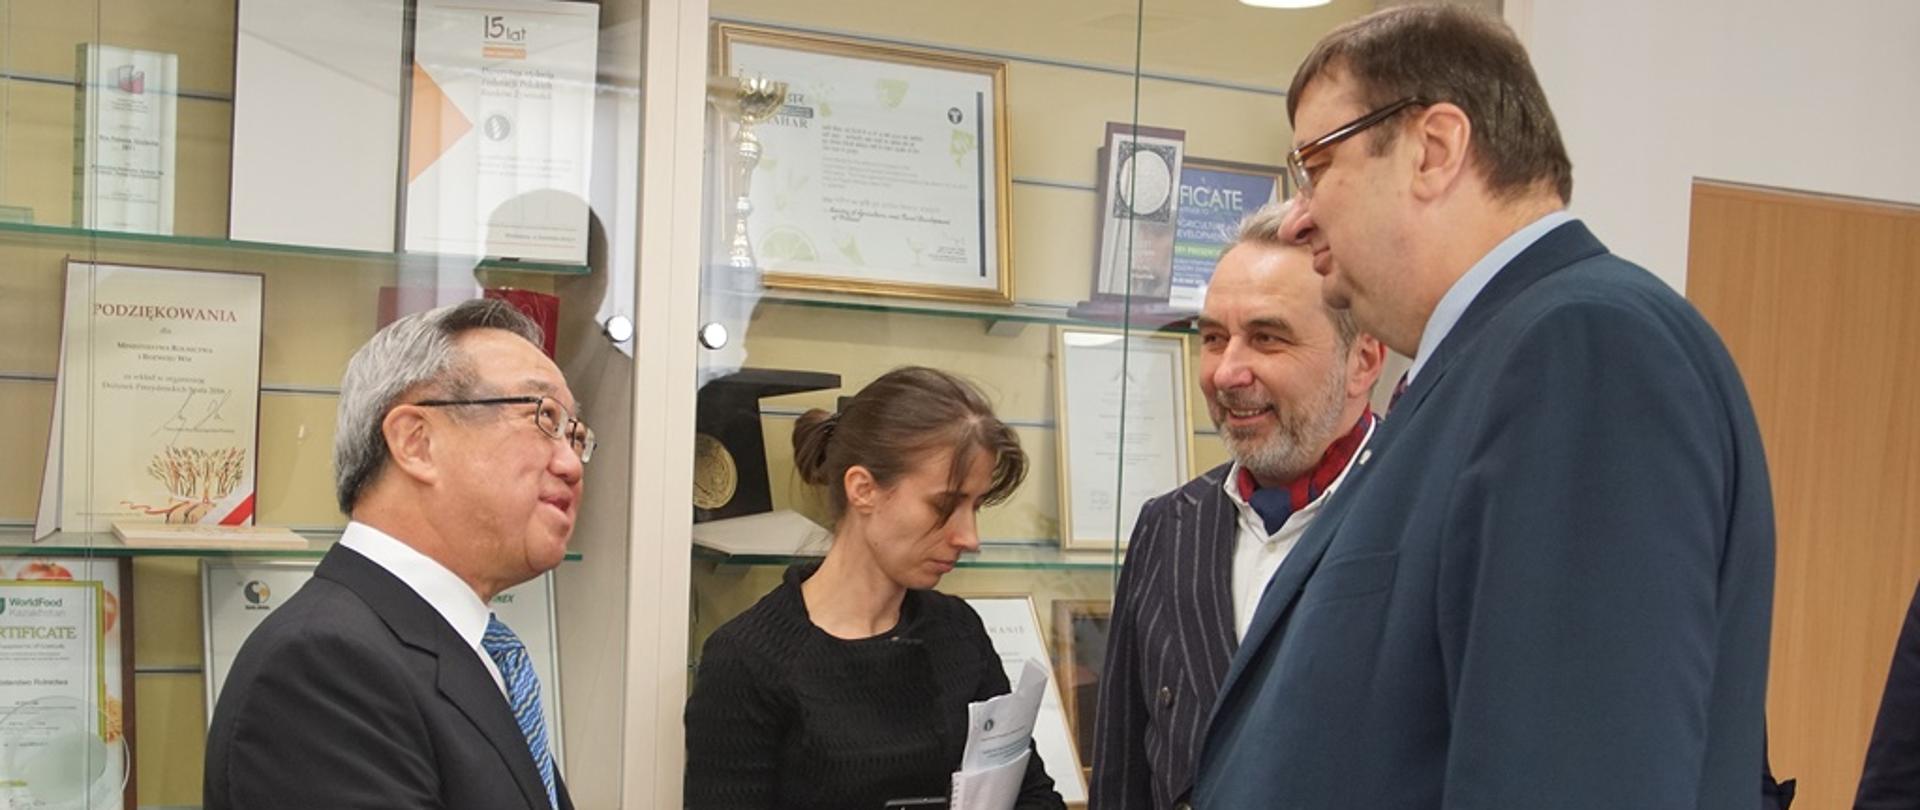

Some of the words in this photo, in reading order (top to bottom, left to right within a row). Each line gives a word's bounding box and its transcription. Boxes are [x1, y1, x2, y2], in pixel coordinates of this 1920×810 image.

[484, 15, 505, 38] 15
[506, 27, 527, 41] lat
[1180, 185, 1243, 211] FICATE
[94, 303, 237, 322] PODZIĘKOWANIA
[9, 597, 63, 608] WorldFood
